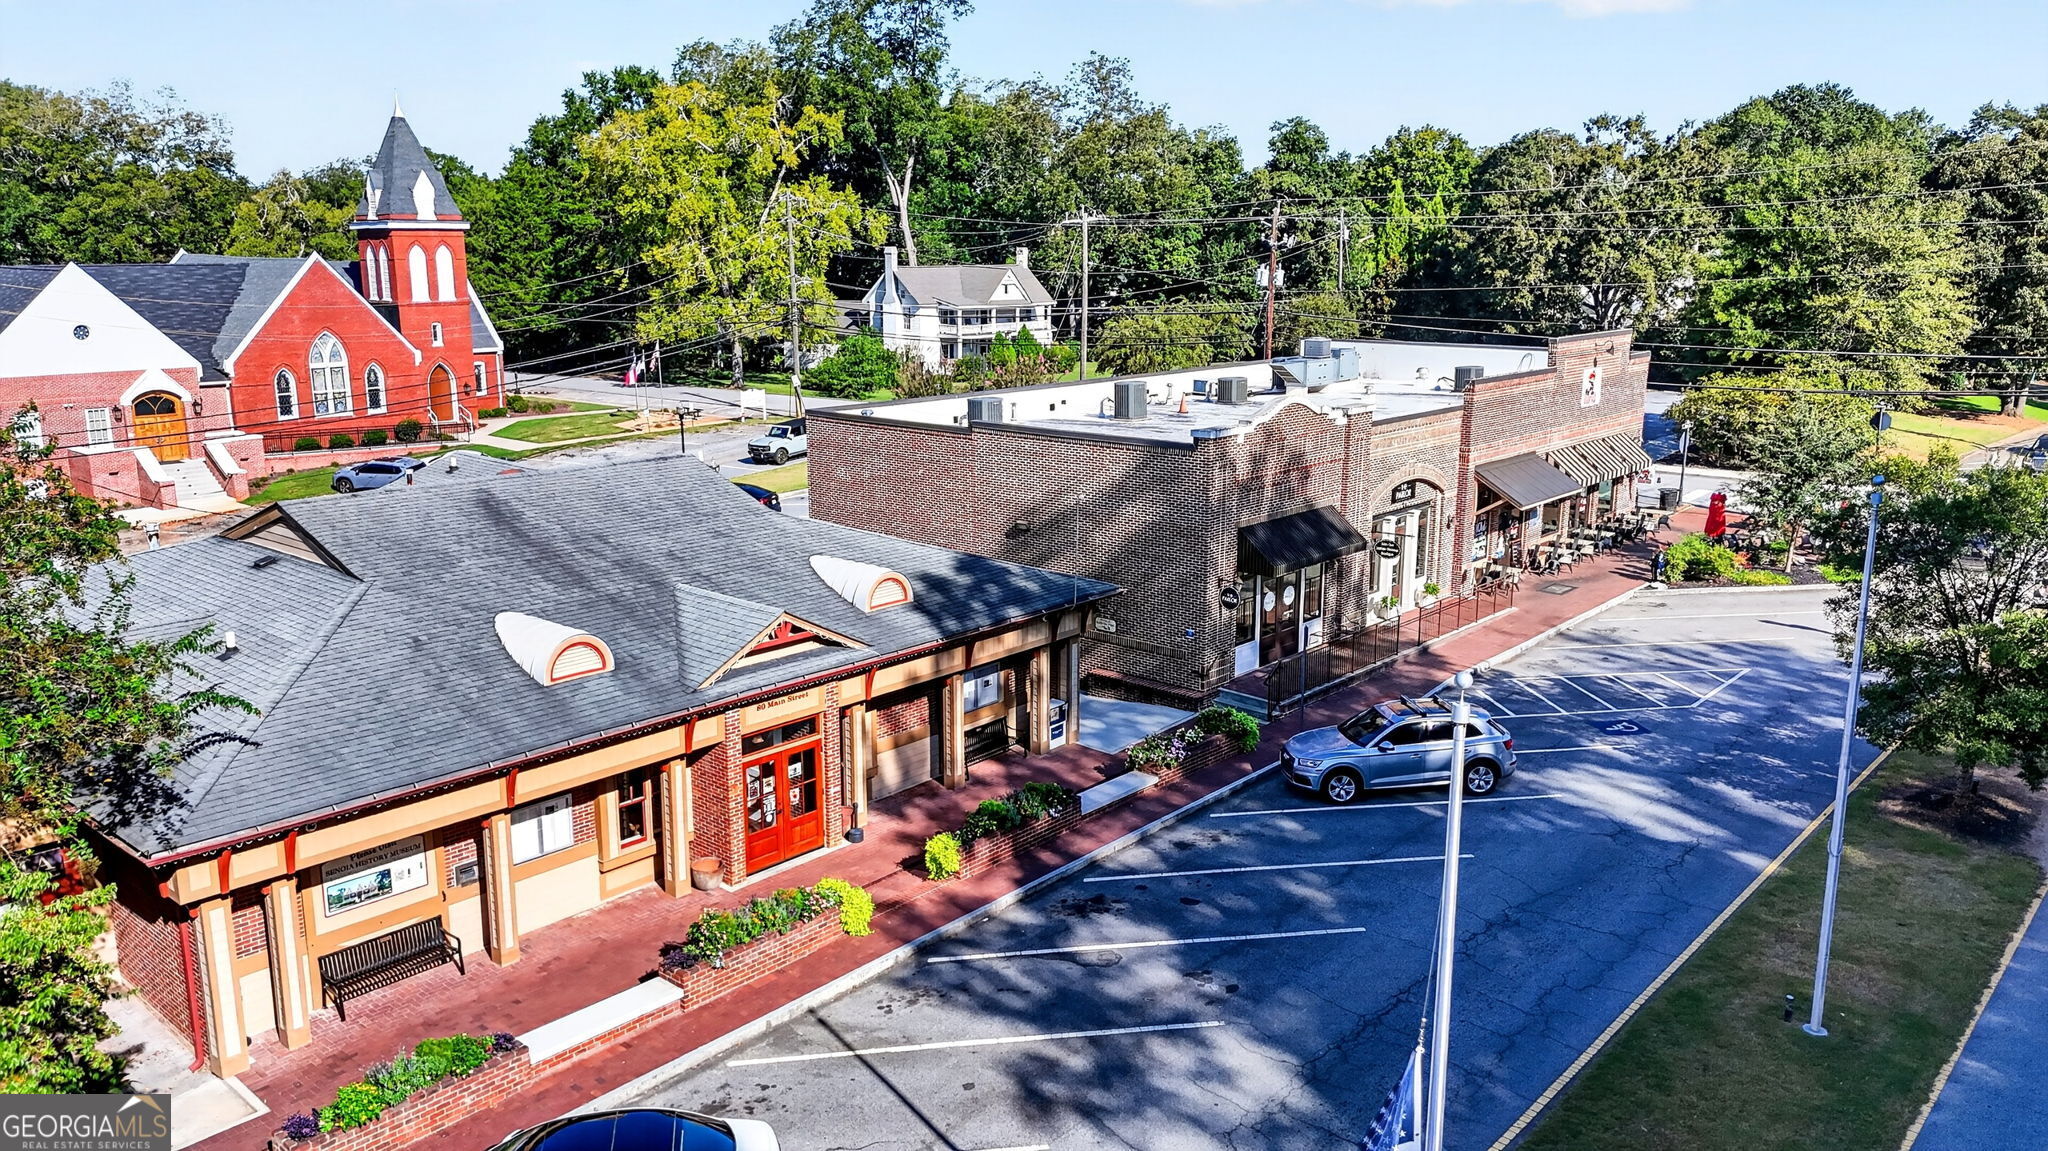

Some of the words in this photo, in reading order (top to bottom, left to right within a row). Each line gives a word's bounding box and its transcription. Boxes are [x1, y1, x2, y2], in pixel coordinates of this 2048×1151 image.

[767, 699, 786, 709] Main
[787, 691, 809, 702] Street
[325, 863, 355, 877] SENOIA
[355, 853, 390, 868] HISTORY
[389, 843, 421, 858] MUSEUM
[349, 846, 377, 862] Please
